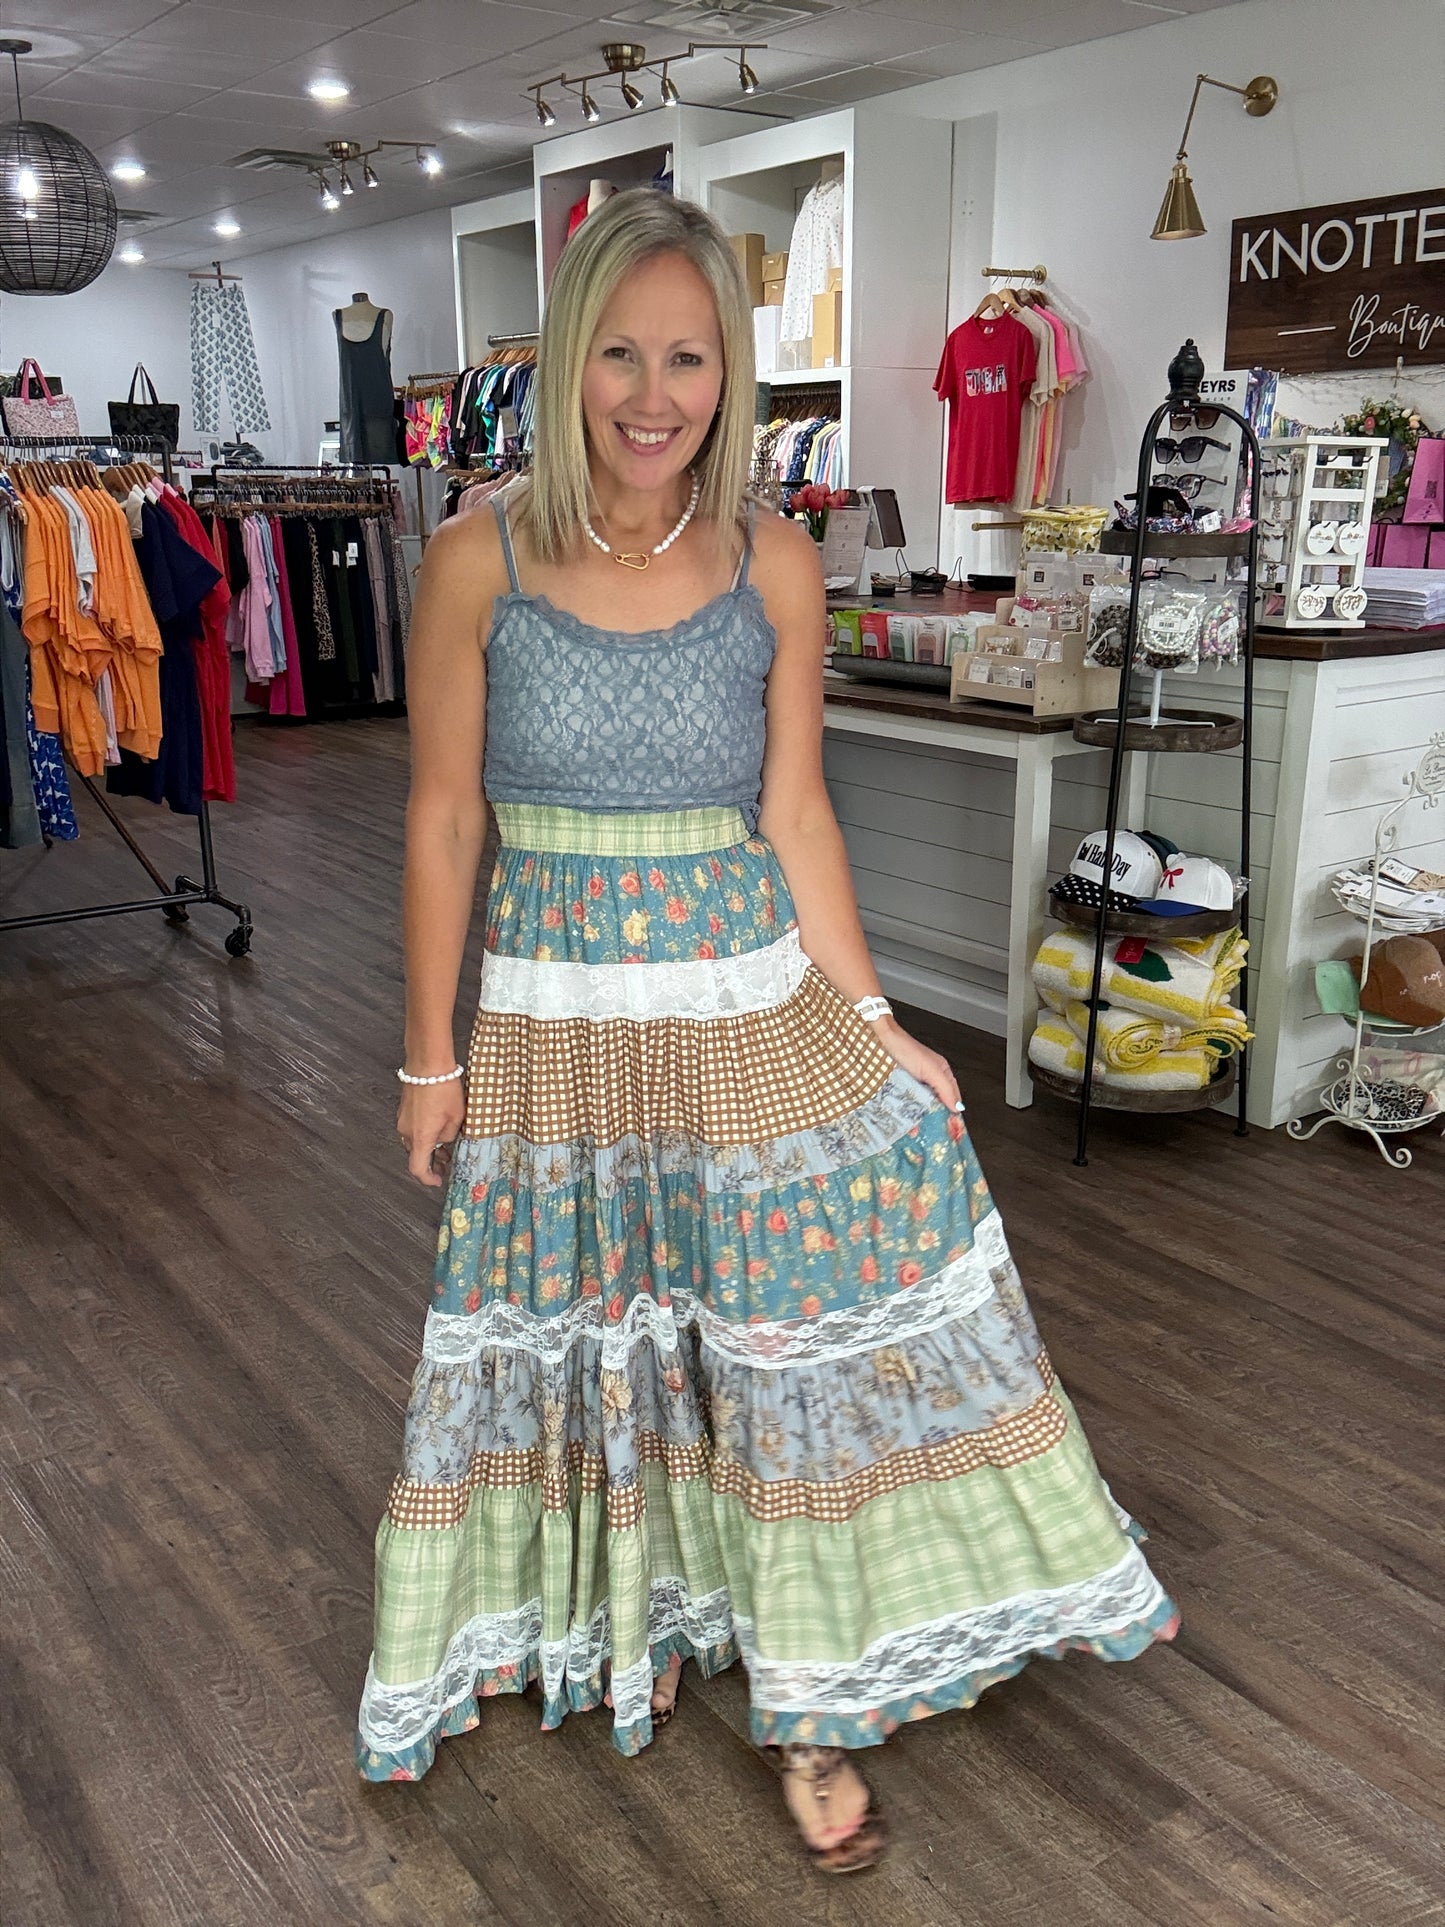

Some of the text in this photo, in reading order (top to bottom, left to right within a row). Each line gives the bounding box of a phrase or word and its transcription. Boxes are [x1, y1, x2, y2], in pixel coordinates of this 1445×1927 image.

[1240, 206, 1445, 282] KNOTTE
[1198, 379, 1236, 393] EYRS
[1110, 853, 1132, 882] Day
